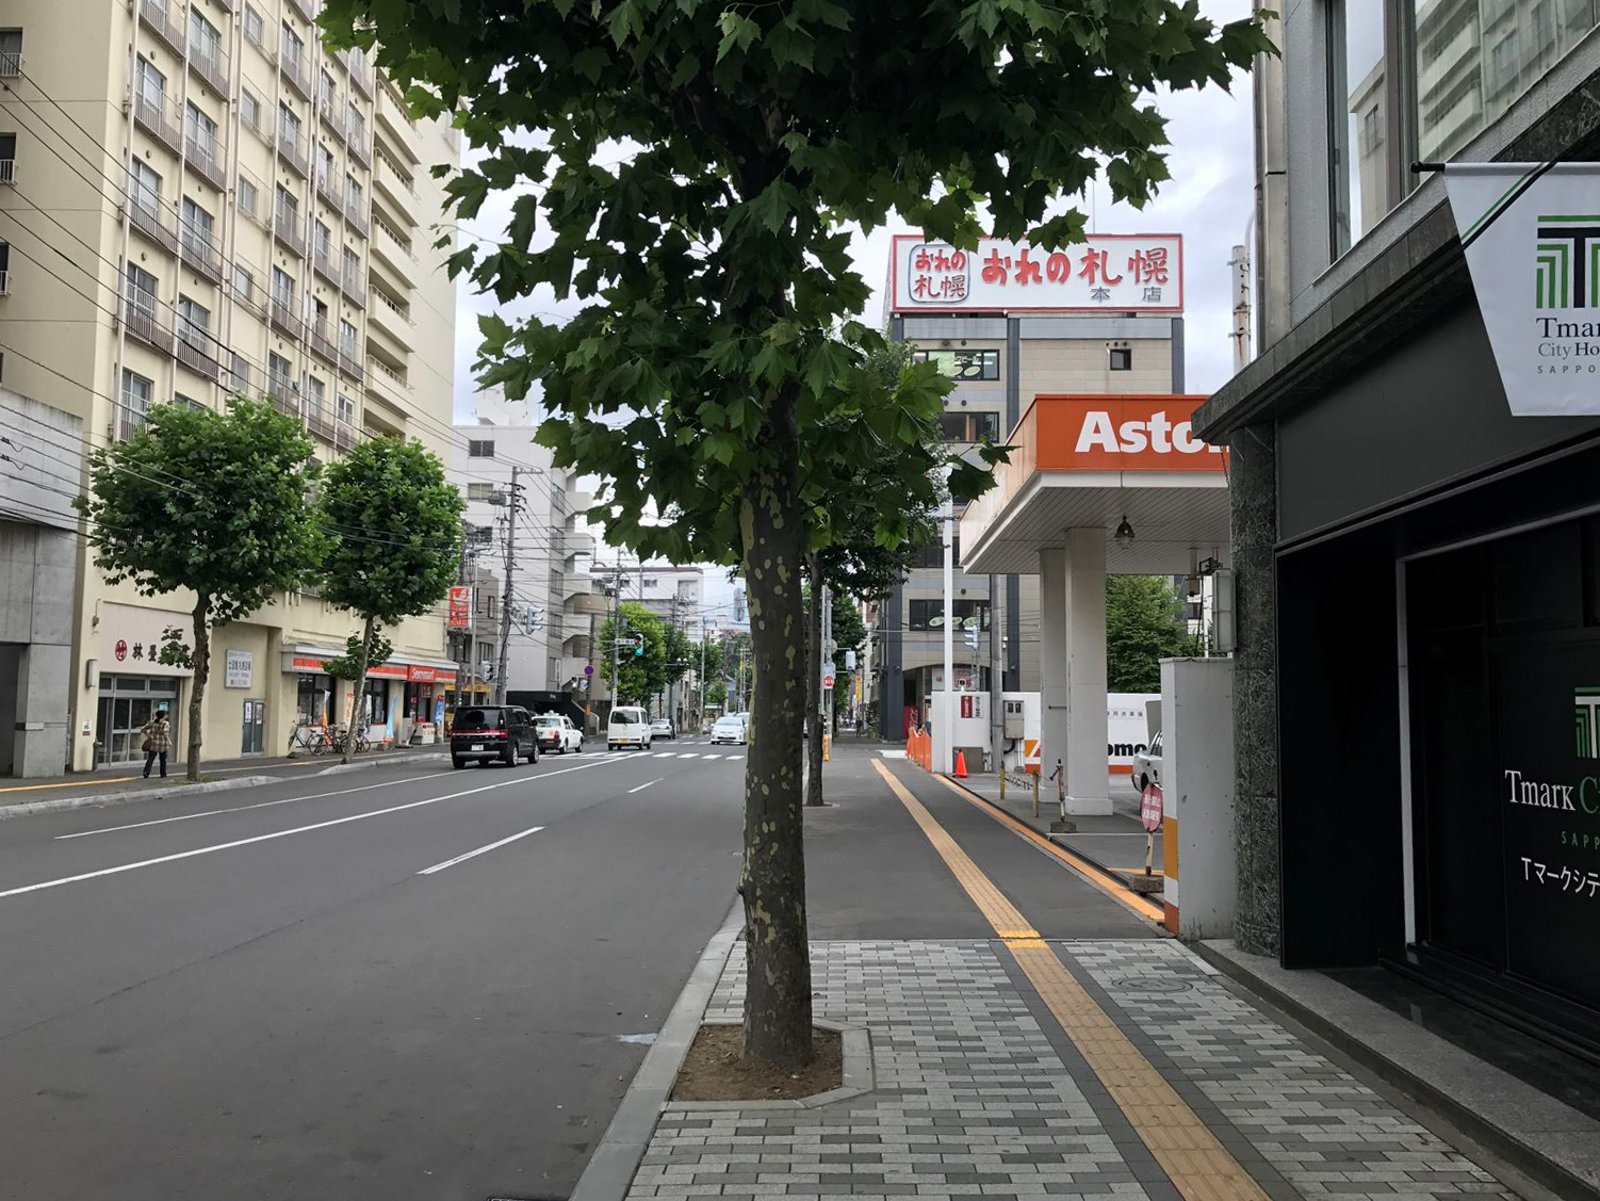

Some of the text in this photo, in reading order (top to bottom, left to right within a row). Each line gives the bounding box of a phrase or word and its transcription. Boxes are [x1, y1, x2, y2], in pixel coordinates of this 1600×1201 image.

[915, 247, 966, 271] おれの
[980, 246, 1170, 286] おれの札幌
[913, 274, 965, 300] 札幌
[1538, 342, 1600, 360] City Ho
[1537, 364, 1597, 374] SAPPO
[1075, 411, 1228, 454] Asto
[1505, 769, 1600, 814] Tmark C
